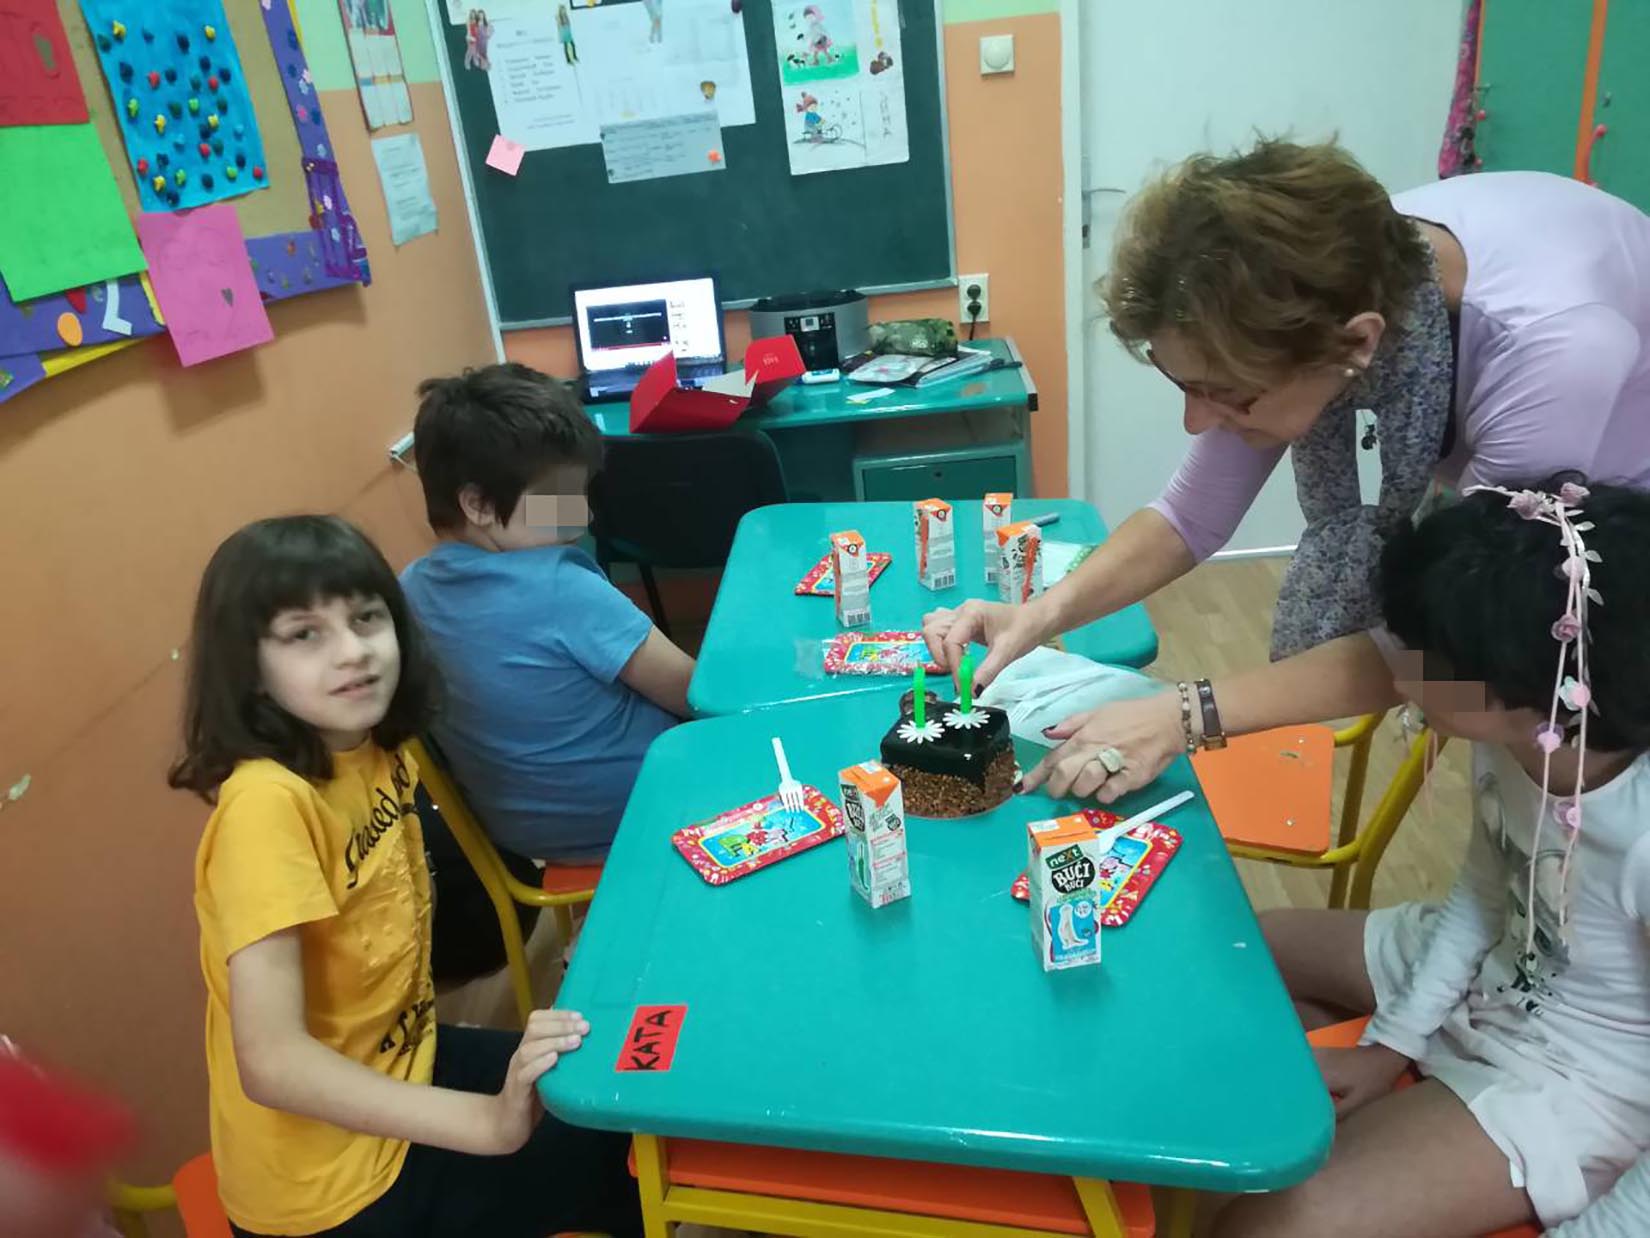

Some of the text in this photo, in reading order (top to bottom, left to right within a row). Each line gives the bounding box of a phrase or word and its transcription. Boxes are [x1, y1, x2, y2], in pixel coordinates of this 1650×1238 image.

[1053, 861, 1091, 887] BUĆI
[1065, 878, 1085, 892] BUĆI
[624, 1010, 672, 1070] KATA
